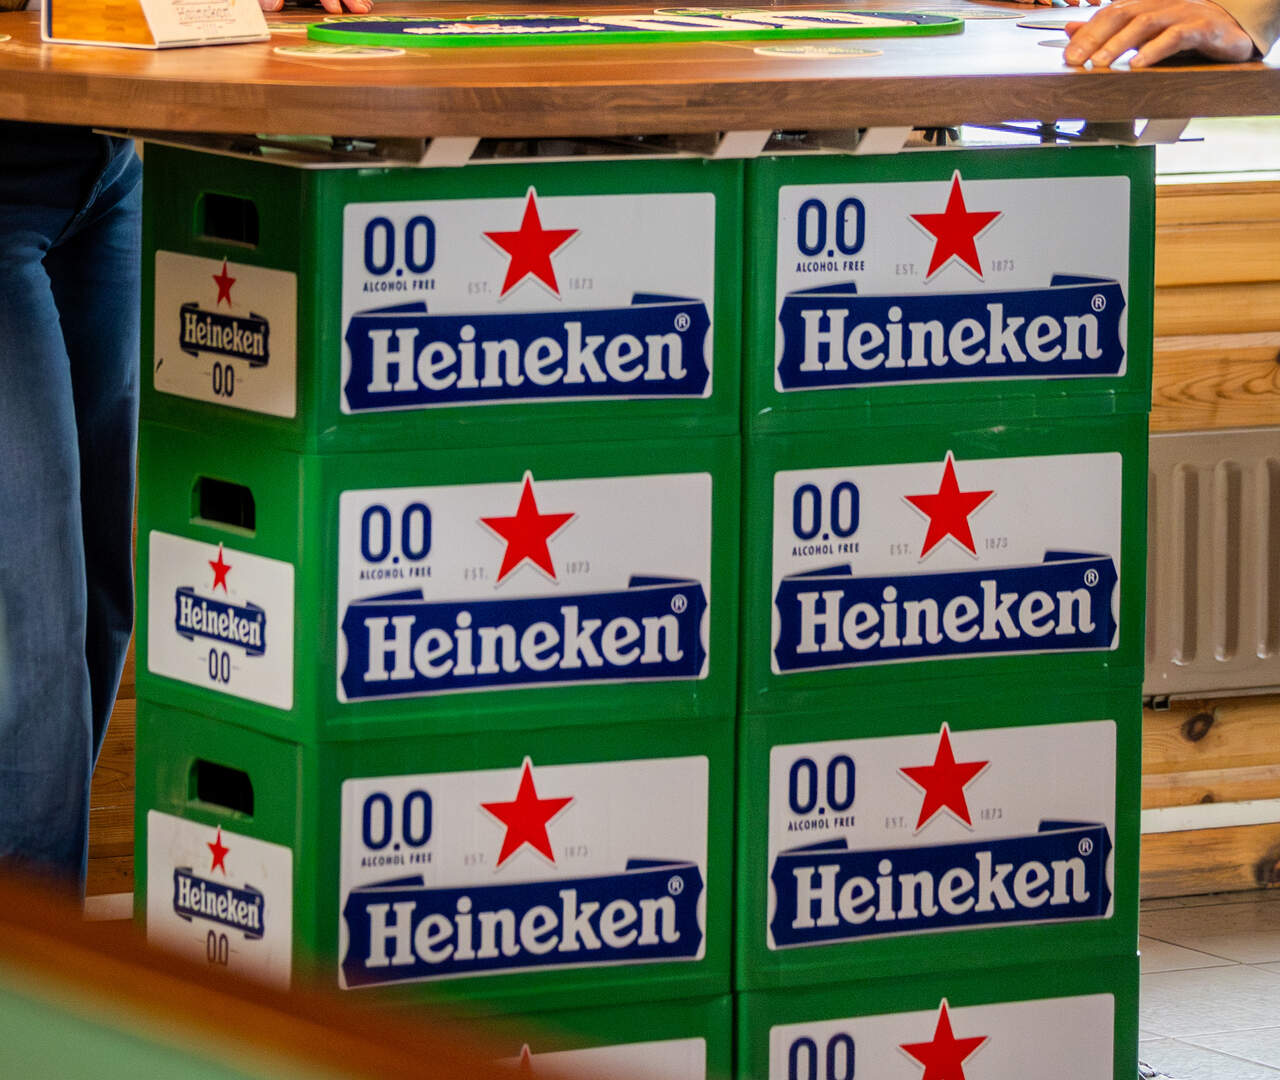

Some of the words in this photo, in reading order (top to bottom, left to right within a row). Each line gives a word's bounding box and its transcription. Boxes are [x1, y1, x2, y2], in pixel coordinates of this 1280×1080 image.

[363, 214, 436, 278] 0.0
[797, 198, 866, 257] 0.0
[363, 280, 407, 292] ALCOHOL
[412, 279, 436, 291] FREE
[796, 261, 838, 272] ALCOHOL
[842, 260, 865, 271] FREE
[183, 311, 266, 358] Heineken
[367, 321, 687, 394] Heineken
[799, 303, 1102, 372] Heineken
[360, 502, 433, 565] 0.0
[792, 481, 860, 541] 0.0
[359, 567, 404, 580] ALCOHOL
[409, 566, 432, 578] FREE
[792, 545, 833, 556] ALCOHOL
[838, 542, 860, 554] FREE
[178, 594, 262, 648] Heineken
[363, 604, 684, 683] Heineken
[796, 580, 1096, 654] Heineken
[788, 754, 856, 816] 0.0
[361, 789, 433, 851] 0.0
[788, 819, 830, 832] ALCOHOL
[834, 816, 855, 828] FREE
[361, 855, 406, 868] ALCOHOL
[409, 852, 433, 865] FREE
[792, 851, 1090, 929] Heineken
[177, 875, 260, 930] Heineken
[365, 889, 681, 968] Heineken
